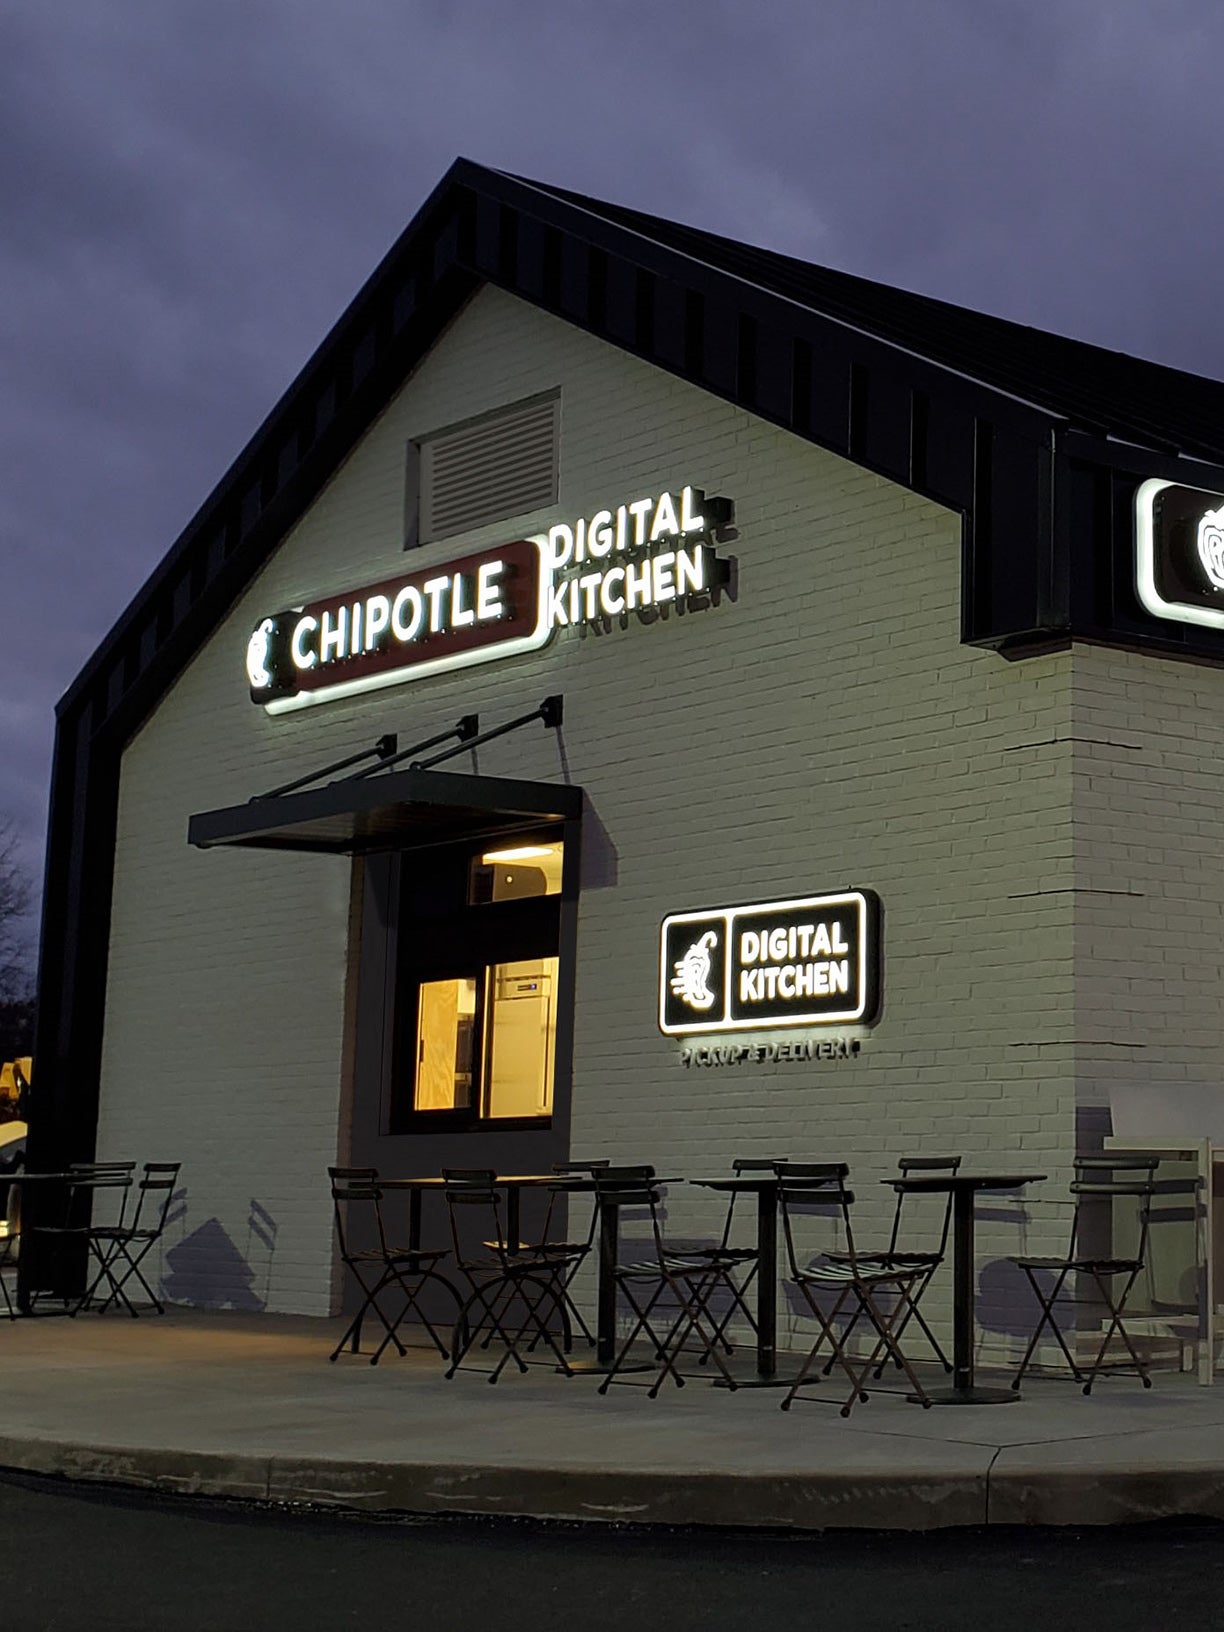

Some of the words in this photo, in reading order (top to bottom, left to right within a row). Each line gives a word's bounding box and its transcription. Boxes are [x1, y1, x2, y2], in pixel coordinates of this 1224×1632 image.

[548, 486, 704, 570] DIGITAL
[291, 561, 503, 670] CHIPOTLE
[547, 545, 704, 629] KITCHEN
[740, 922, 849, 965] DIGITAL
[740, 959, 849, 1002] KITCHEN
